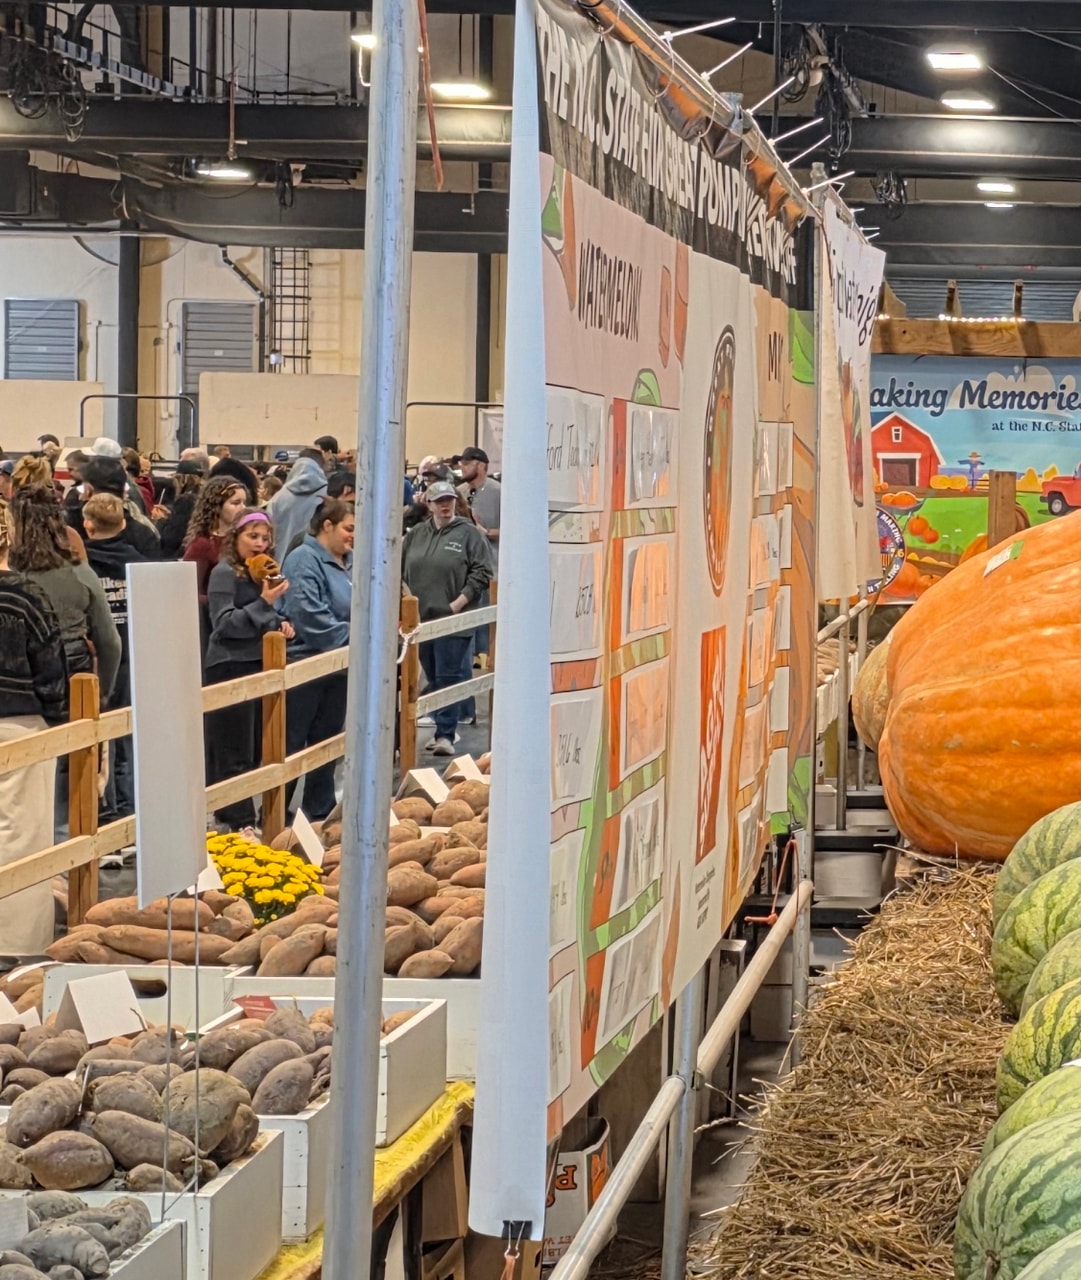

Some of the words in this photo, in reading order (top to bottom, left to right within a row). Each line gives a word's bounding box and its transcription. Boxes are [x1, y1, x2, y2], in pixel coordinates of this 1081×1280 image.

[870, 377, 948, 417] aking
[992, 422, 1004, 432] at
[1009, 420, 1028, 432] the
[1032, 421, 1055, 432] N.C.
